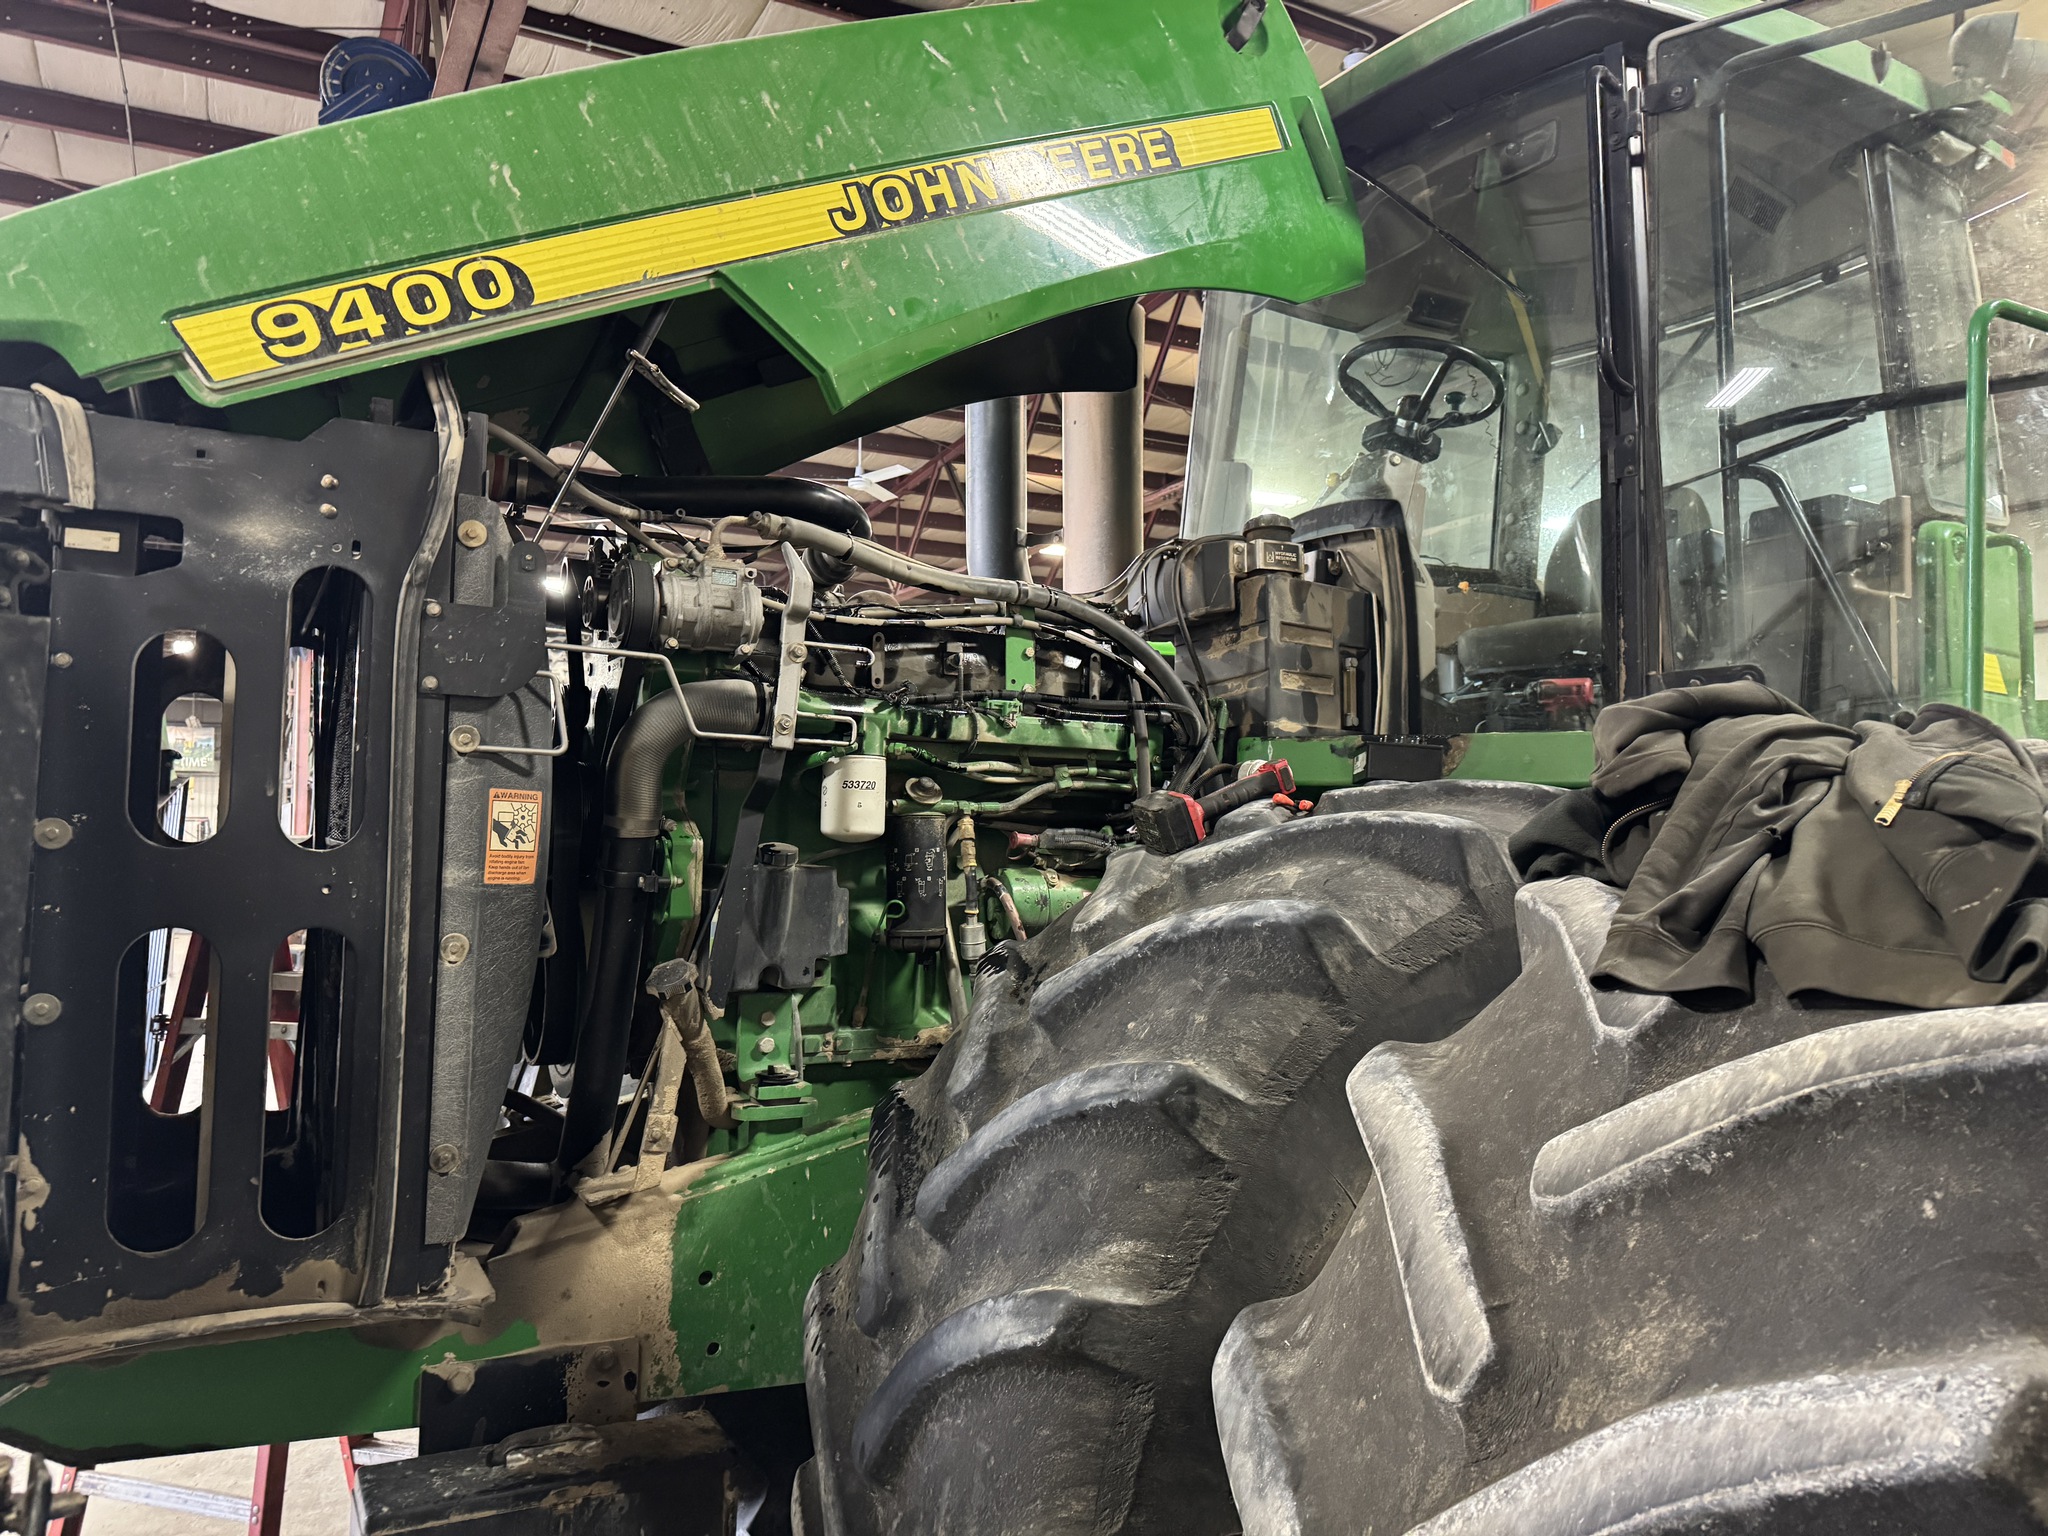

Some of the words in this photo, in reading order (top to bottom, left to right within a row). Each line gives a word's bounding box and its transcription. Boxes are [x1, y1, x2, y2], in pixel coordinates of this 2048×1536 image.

[829, 156, 1000, 233] JOHN
[997, 127, 1181, 202] EERE
[251, 256, 534, 365] 9400
[500, 792, 538, 800] WARNING
[841, 780, 876, 790] 533720
